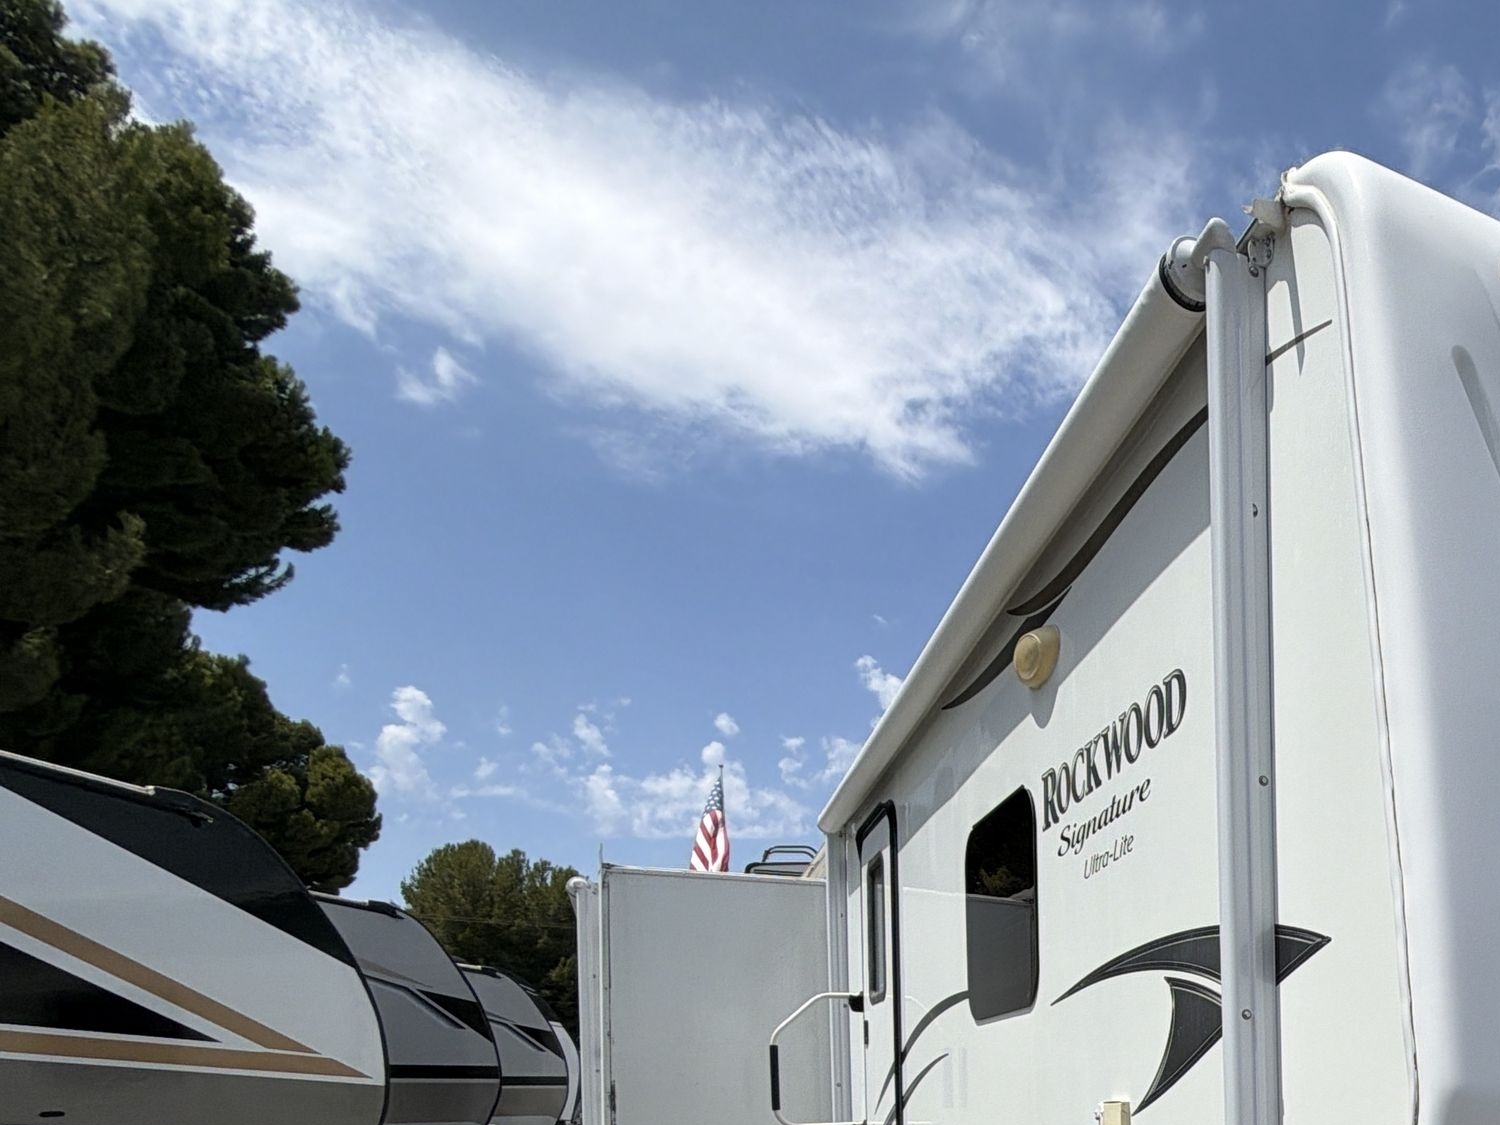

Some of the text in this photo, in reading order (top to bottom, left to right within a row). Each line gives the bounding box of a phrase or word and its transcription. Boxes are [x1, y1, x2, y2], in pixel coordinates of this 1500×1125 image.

[1042, 668, 1187, 832] ROCKWOOD
[1058, 778, 1151, 857] Signature
[1084, 834, 1134, 879] Ultra-Lite
